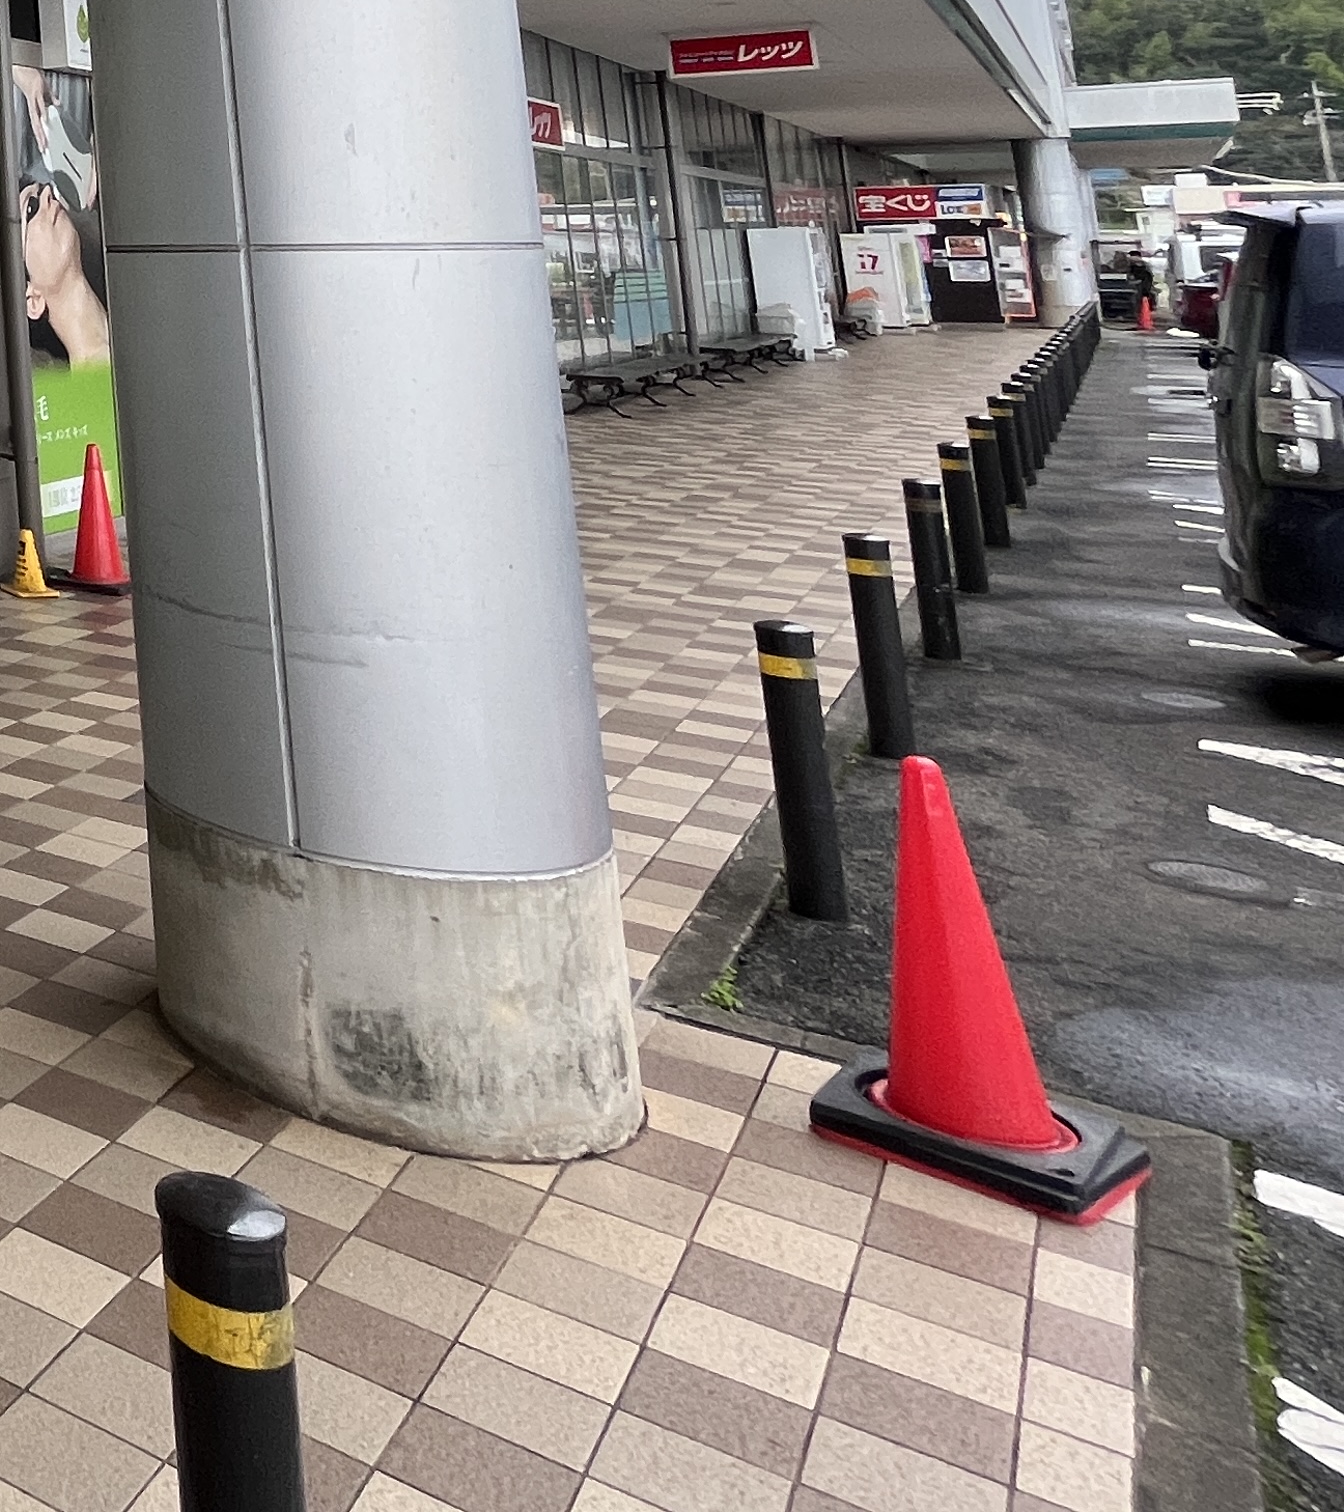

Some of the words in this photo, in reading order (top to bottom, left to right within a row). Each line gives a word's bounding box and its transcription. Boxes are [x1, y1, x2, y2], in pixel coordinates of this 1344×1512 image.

[737, 40, 804, 63] レッツ
[858, 194, 931, 213] 宝くじ
